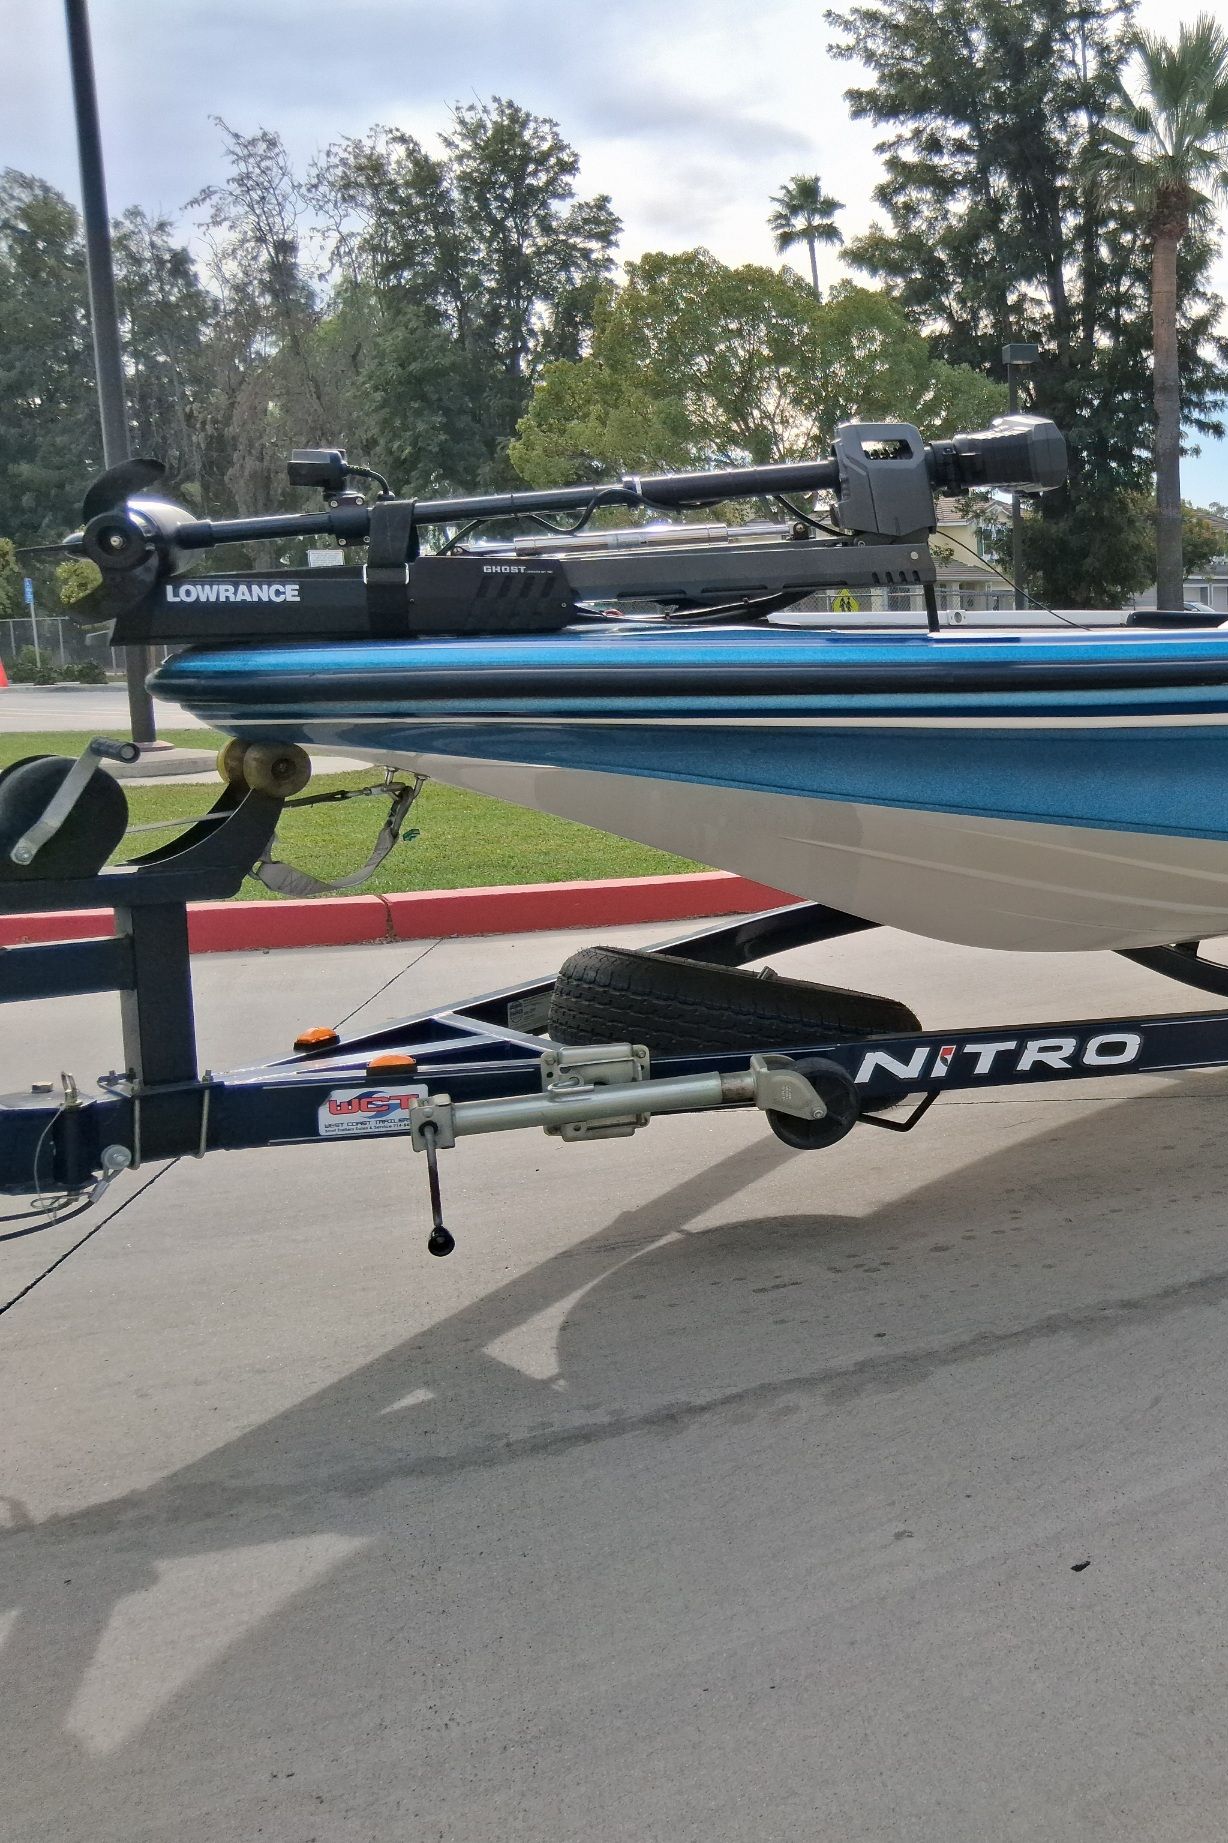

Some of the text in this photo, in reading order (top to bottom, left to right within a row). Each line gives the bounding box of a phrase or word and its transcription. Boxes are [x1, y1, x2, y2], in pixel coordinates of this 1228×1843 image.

[483, 565, 526, 573] GHOST
[166, 584, 301, 602] LOWRANCE
[854, 1033, 1141, 1083] NITRO
